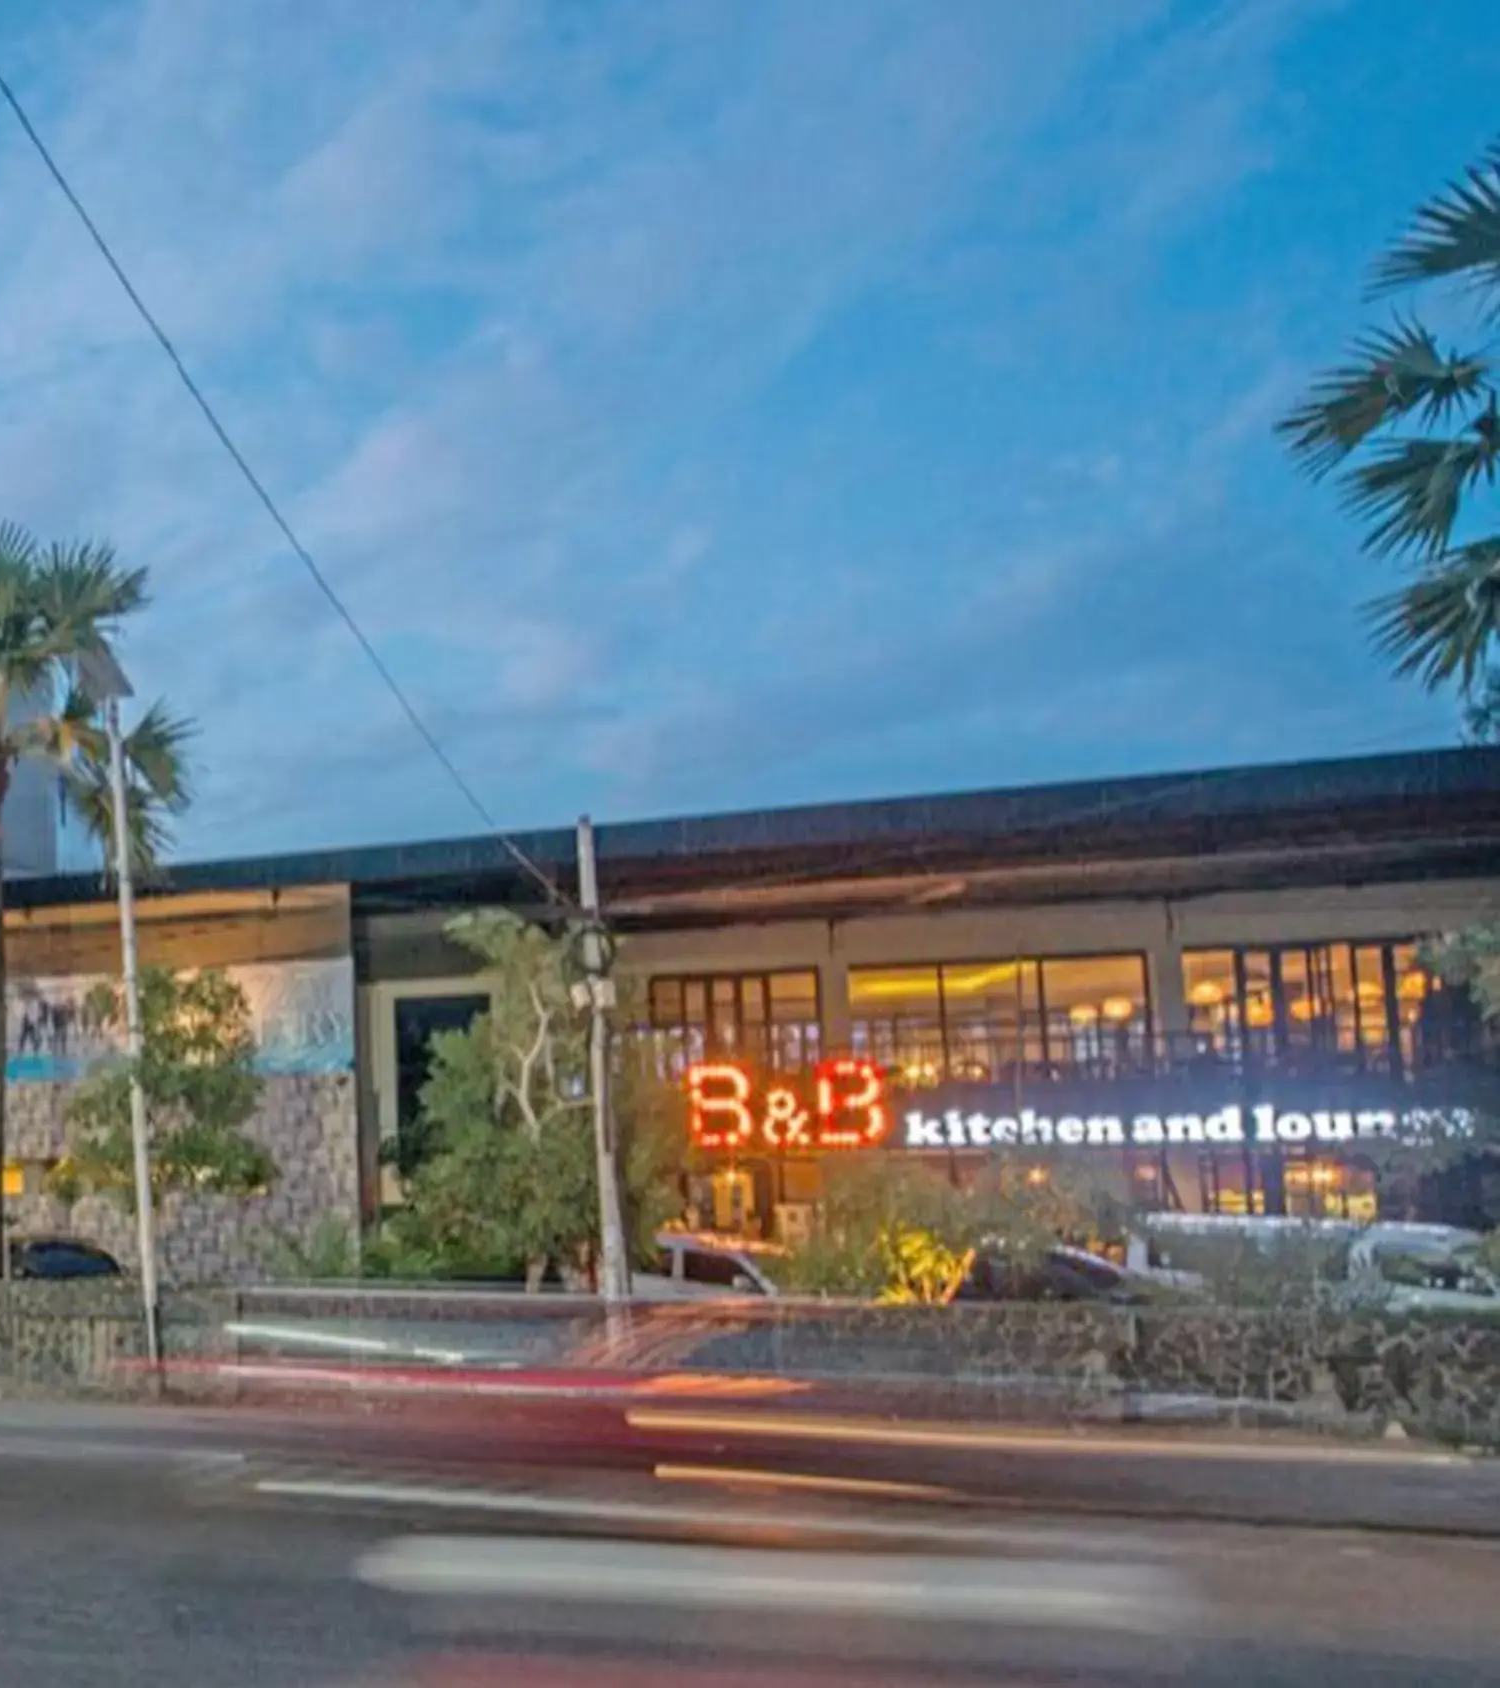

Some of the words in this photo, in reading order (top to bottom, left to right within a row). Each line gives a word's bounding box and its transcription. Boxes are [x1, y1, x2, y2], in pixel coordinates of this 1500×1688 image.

[688, 1060, 886, 1148] B&B
[904, 1108, 1124, 1145] kitchen
[1131, 1104, 1244, 1144] and
